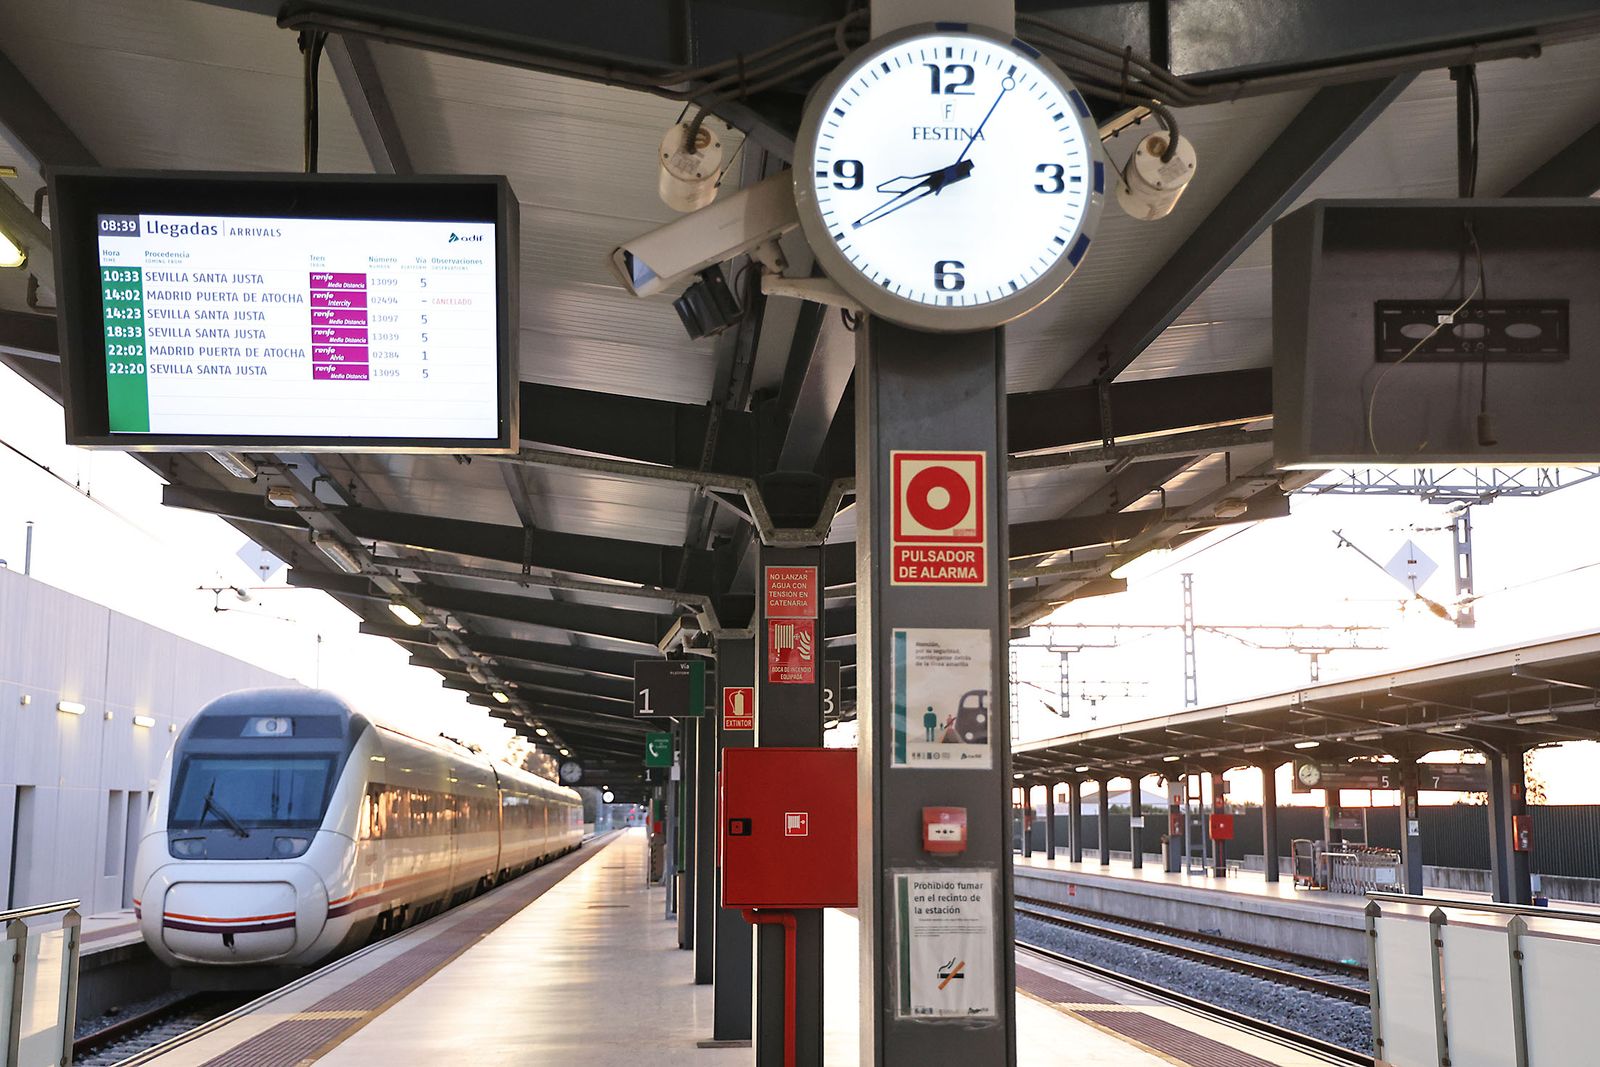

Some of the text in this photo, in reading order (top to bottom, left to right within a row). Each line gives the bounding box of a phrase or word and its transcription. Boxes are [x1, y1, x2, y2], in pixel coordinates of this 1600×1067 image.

[923, 63, 975, 95] 12
[912, 127, 985, 141] FESTINA
[833, 160, 864, 191] 9
[1034, 163, 1065, 194] 3
[101, 219, 137, 232] 08:39
[146, 220, 218, 238] Llegadas
[229, 227, 282, 237] ARRIVALS
[102, 249, 120, 257] Hora
[144, 250, 190, 259] Procedencia
[431, 257, 483, 265] Observaciones
[104, 270, 140, 282] 10:33
[145, 271, 264, 284] SEVILLA SANTA JUSTA
[371, 278, 398, 286] 13099
[934, 260, 965, 292] 6
[420, 278, 427, 288] 5
[104, 289, 141, 301] 14:02
[146, 290, 304, 304] MADRID PUERTA DE ATOCHA
[327, 300, 352, 308] Intercity
[432, 298, 472, 306] CANCELADO
[106, 308, 142, 319] 14:23
[147, 309, 265, 321] SEVILLA SANTA JUSTA
[421, 315, 428, 325] 5
[107, 326, 142, 338] 18:33
[148, 327, 266, 339] SEVILLA SANTA JUSTA
[421, 333, 428, 343] 5
[108, 344, 143, 356] 22:02
[149, 345, 306, 358] MADRID PUERTA DE ATOCHA
[422, 351, 429, 360] 1
[109, 363, 145, 374] 22:20
[150, 364, 268, 376] SEVILLA SANTA JUSTA
[373, 369, 400, 377] 13095
[422, 369, 429, 379] 5
[901, 550, 975, 562] PULSADOR
[899, 566, 977, 579] DE ALARMA
[769, 590, 798, 598] TENSIÓN
[639, 688, 654, 714] 1
[726, 719, 752, 727] EXTINTOR
[645, 769, 652, 781] 1
[1382, 776, 1389, 788] 5
[1432, 777, 1440, 788] 7
[914, 882, 984, 890] Prohibido fumar
[927, 894, 935, 902] el
[938, 893, 967, 902] recinto
[970, 894, 981, 902] de
[914, 905, 961, 914] la estación
